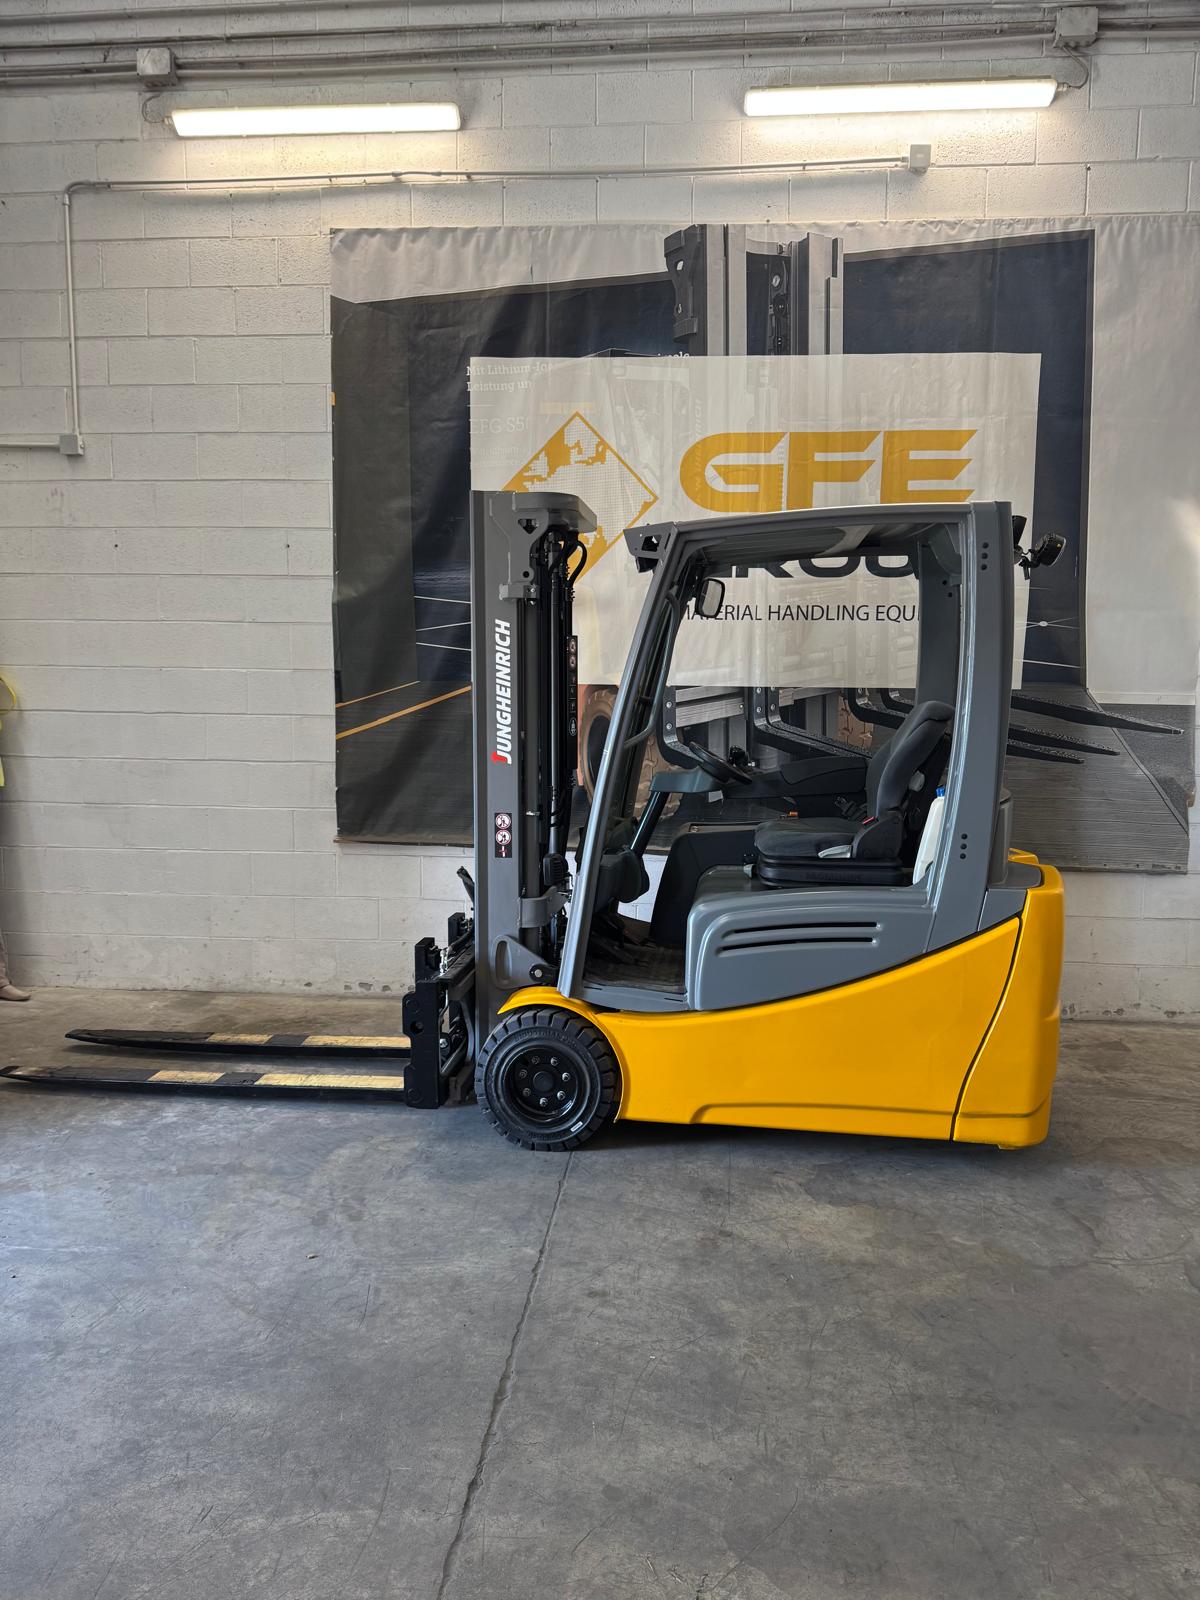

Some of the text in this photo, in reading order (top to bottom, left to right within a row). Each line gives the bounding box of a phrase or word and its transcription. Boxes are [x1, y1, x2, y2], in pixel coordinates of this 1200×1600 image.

[680, 429, 977, 512] GFE
[768, 604, 870, 621] HANDLING
[491, 618, 512, 765] JUNGHEINRICH
